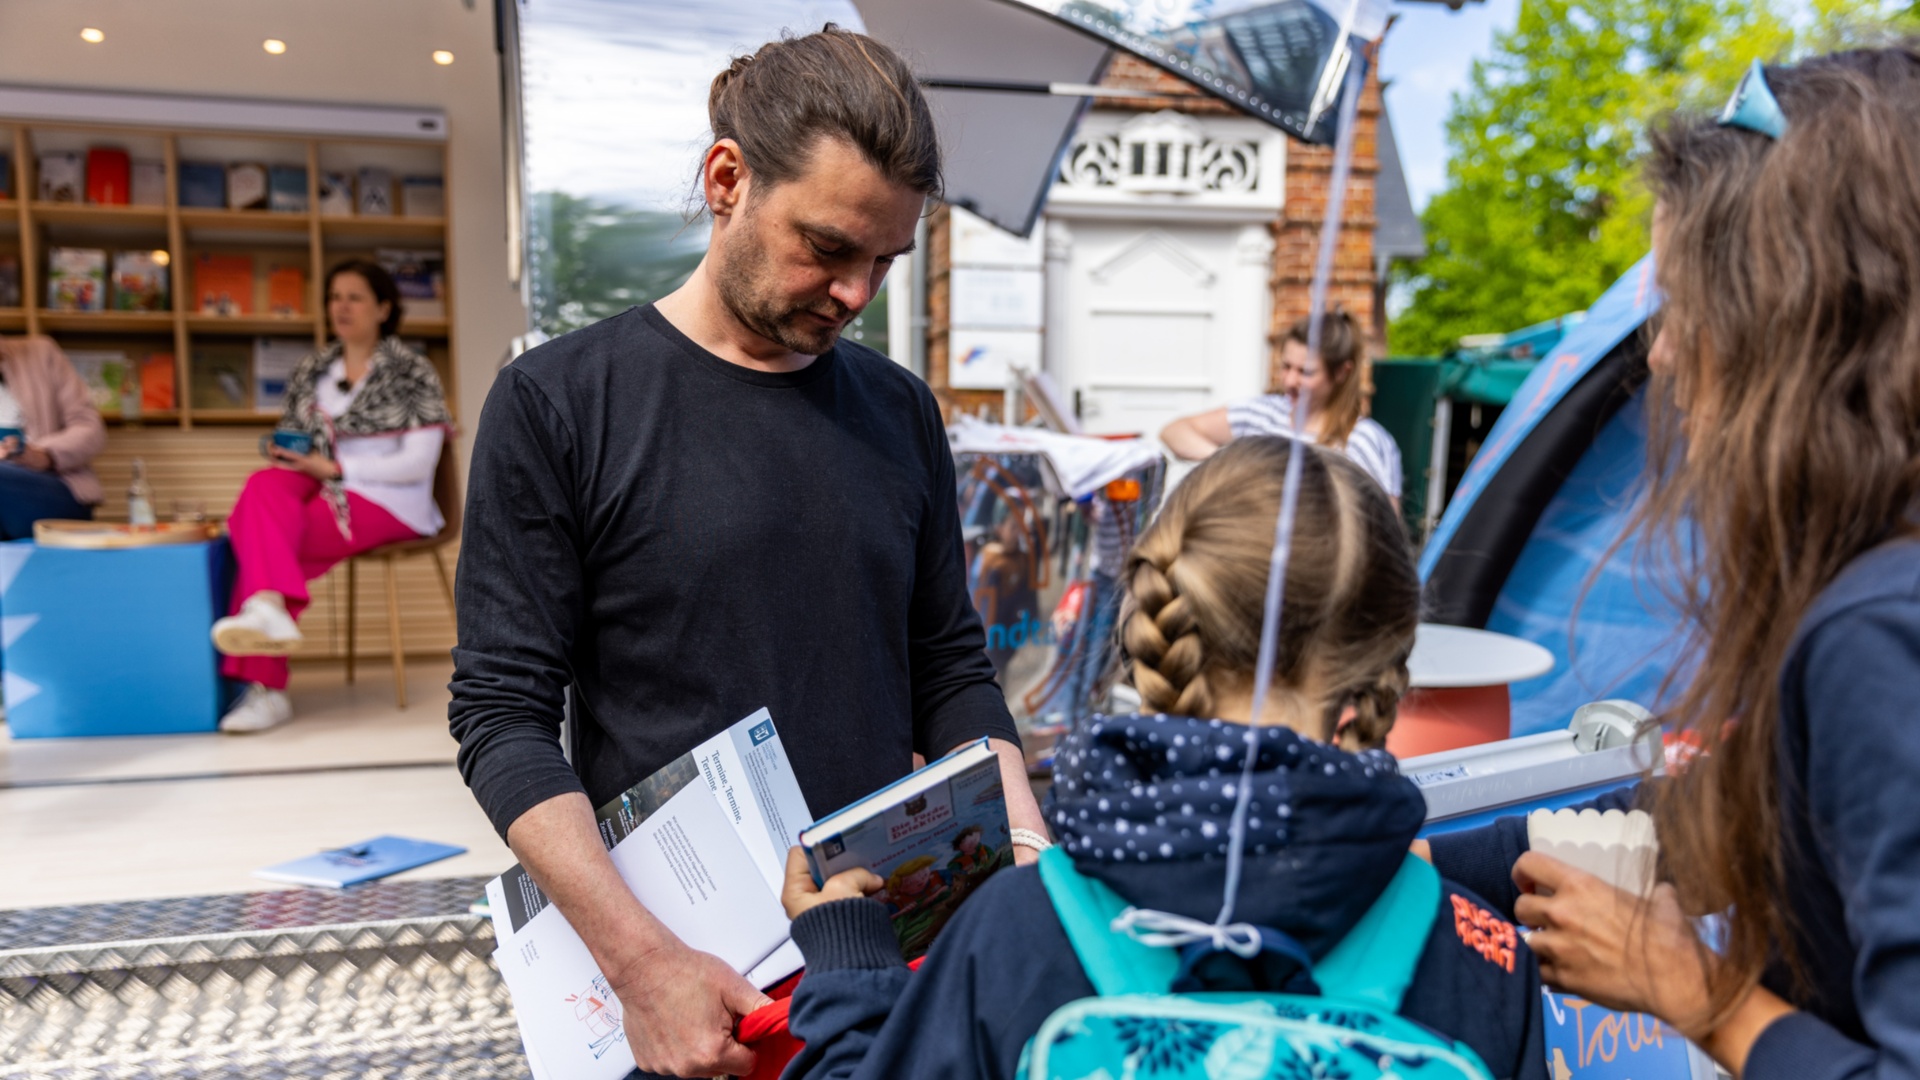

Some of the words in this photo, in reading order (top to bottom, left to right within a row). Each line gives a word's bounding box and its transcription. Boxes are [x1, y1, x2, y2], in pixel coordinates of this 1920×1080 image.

[701, 756, 719, 793] Termine
[711, 750, 730, 790] Termine,
[725, 786, 743, 827] Termine,
[890, 820, 910, 834] Die
